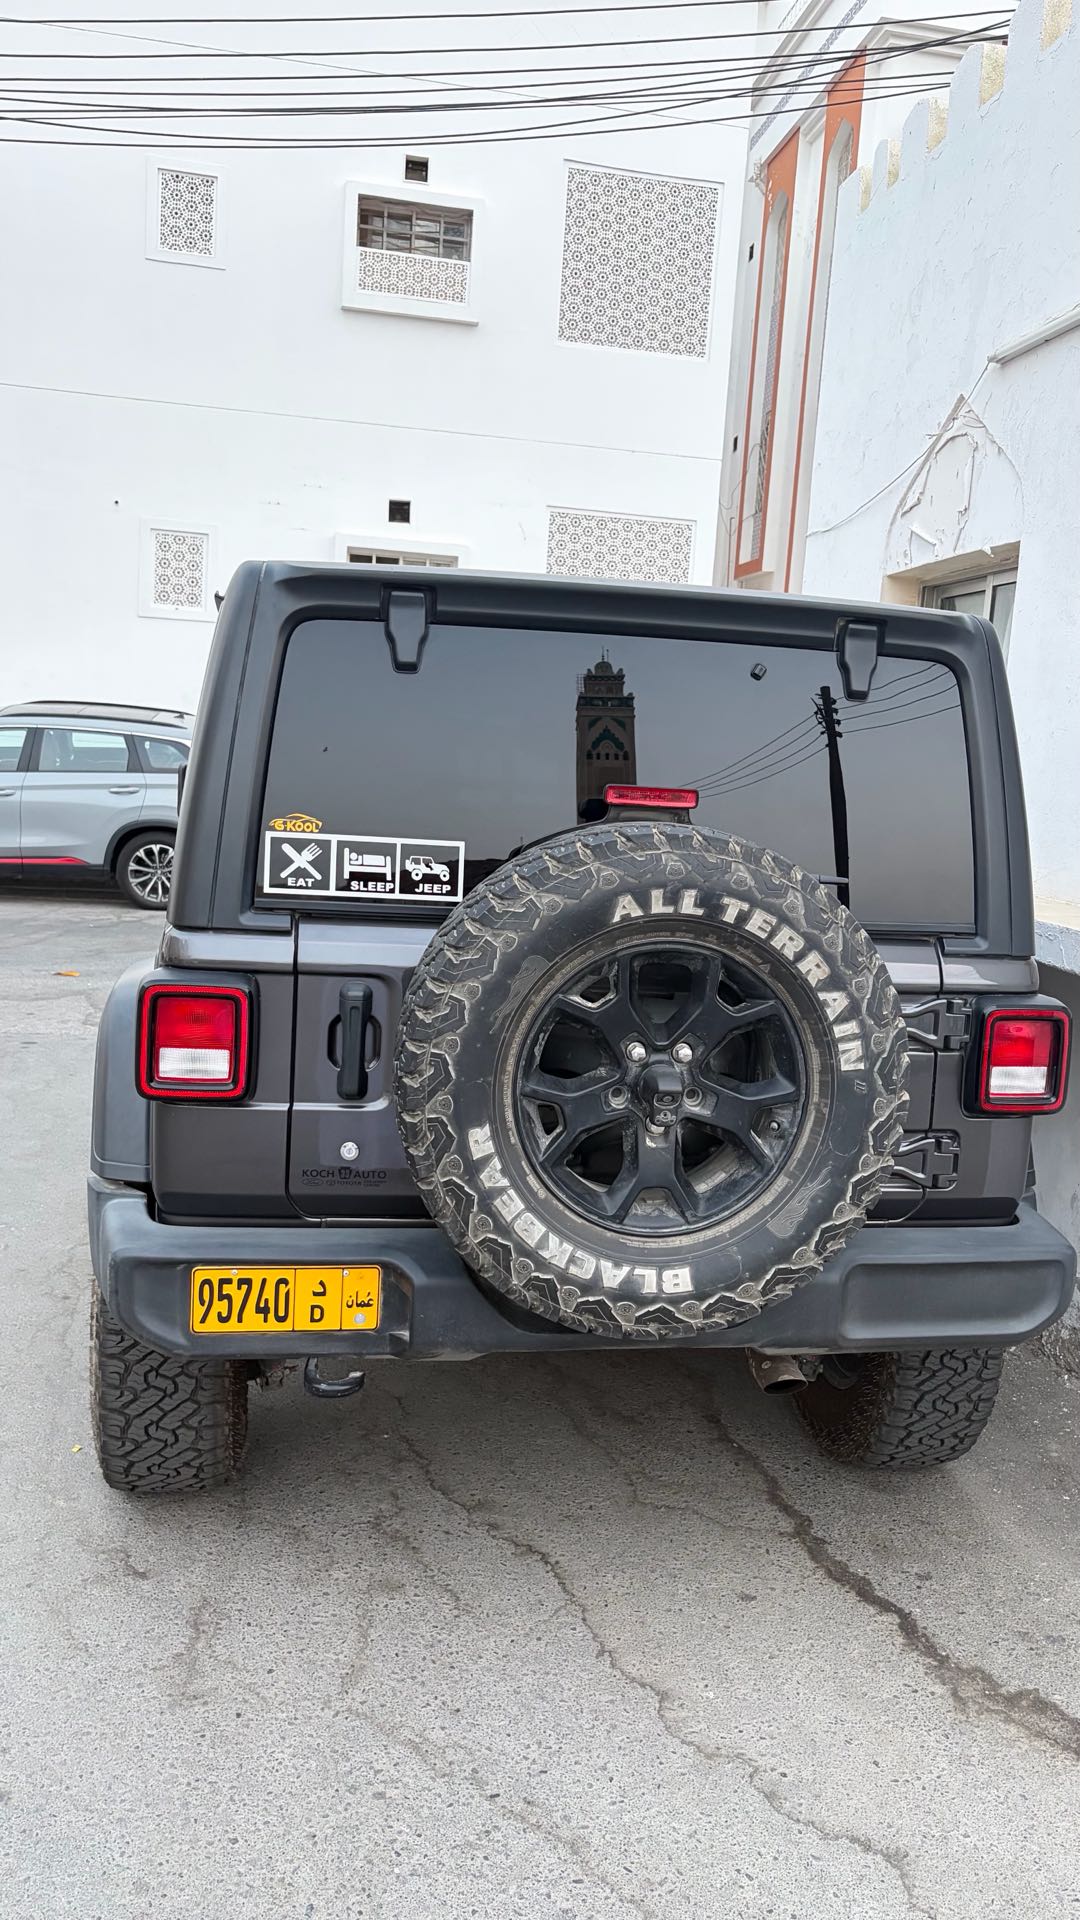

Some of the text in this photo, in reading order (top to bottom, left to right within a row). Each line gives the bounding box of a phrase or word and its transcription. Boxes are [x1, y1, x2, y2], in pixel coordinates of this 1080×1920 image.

[287, 877, 451, 894] EAT SLEEP JEEP
[611, 888, 705, 923] ALL
[720, 896, 865, 1071] TERRAIN
[302, 1169, 387, 1179] KOCH AUTO
[468, 1123, 694, 1294] BLACKBEAR
[312, 1279, 327, 1297] د
[198, 1277, 290, 1324] 95740
[309, 1305, 325, 1323] D
